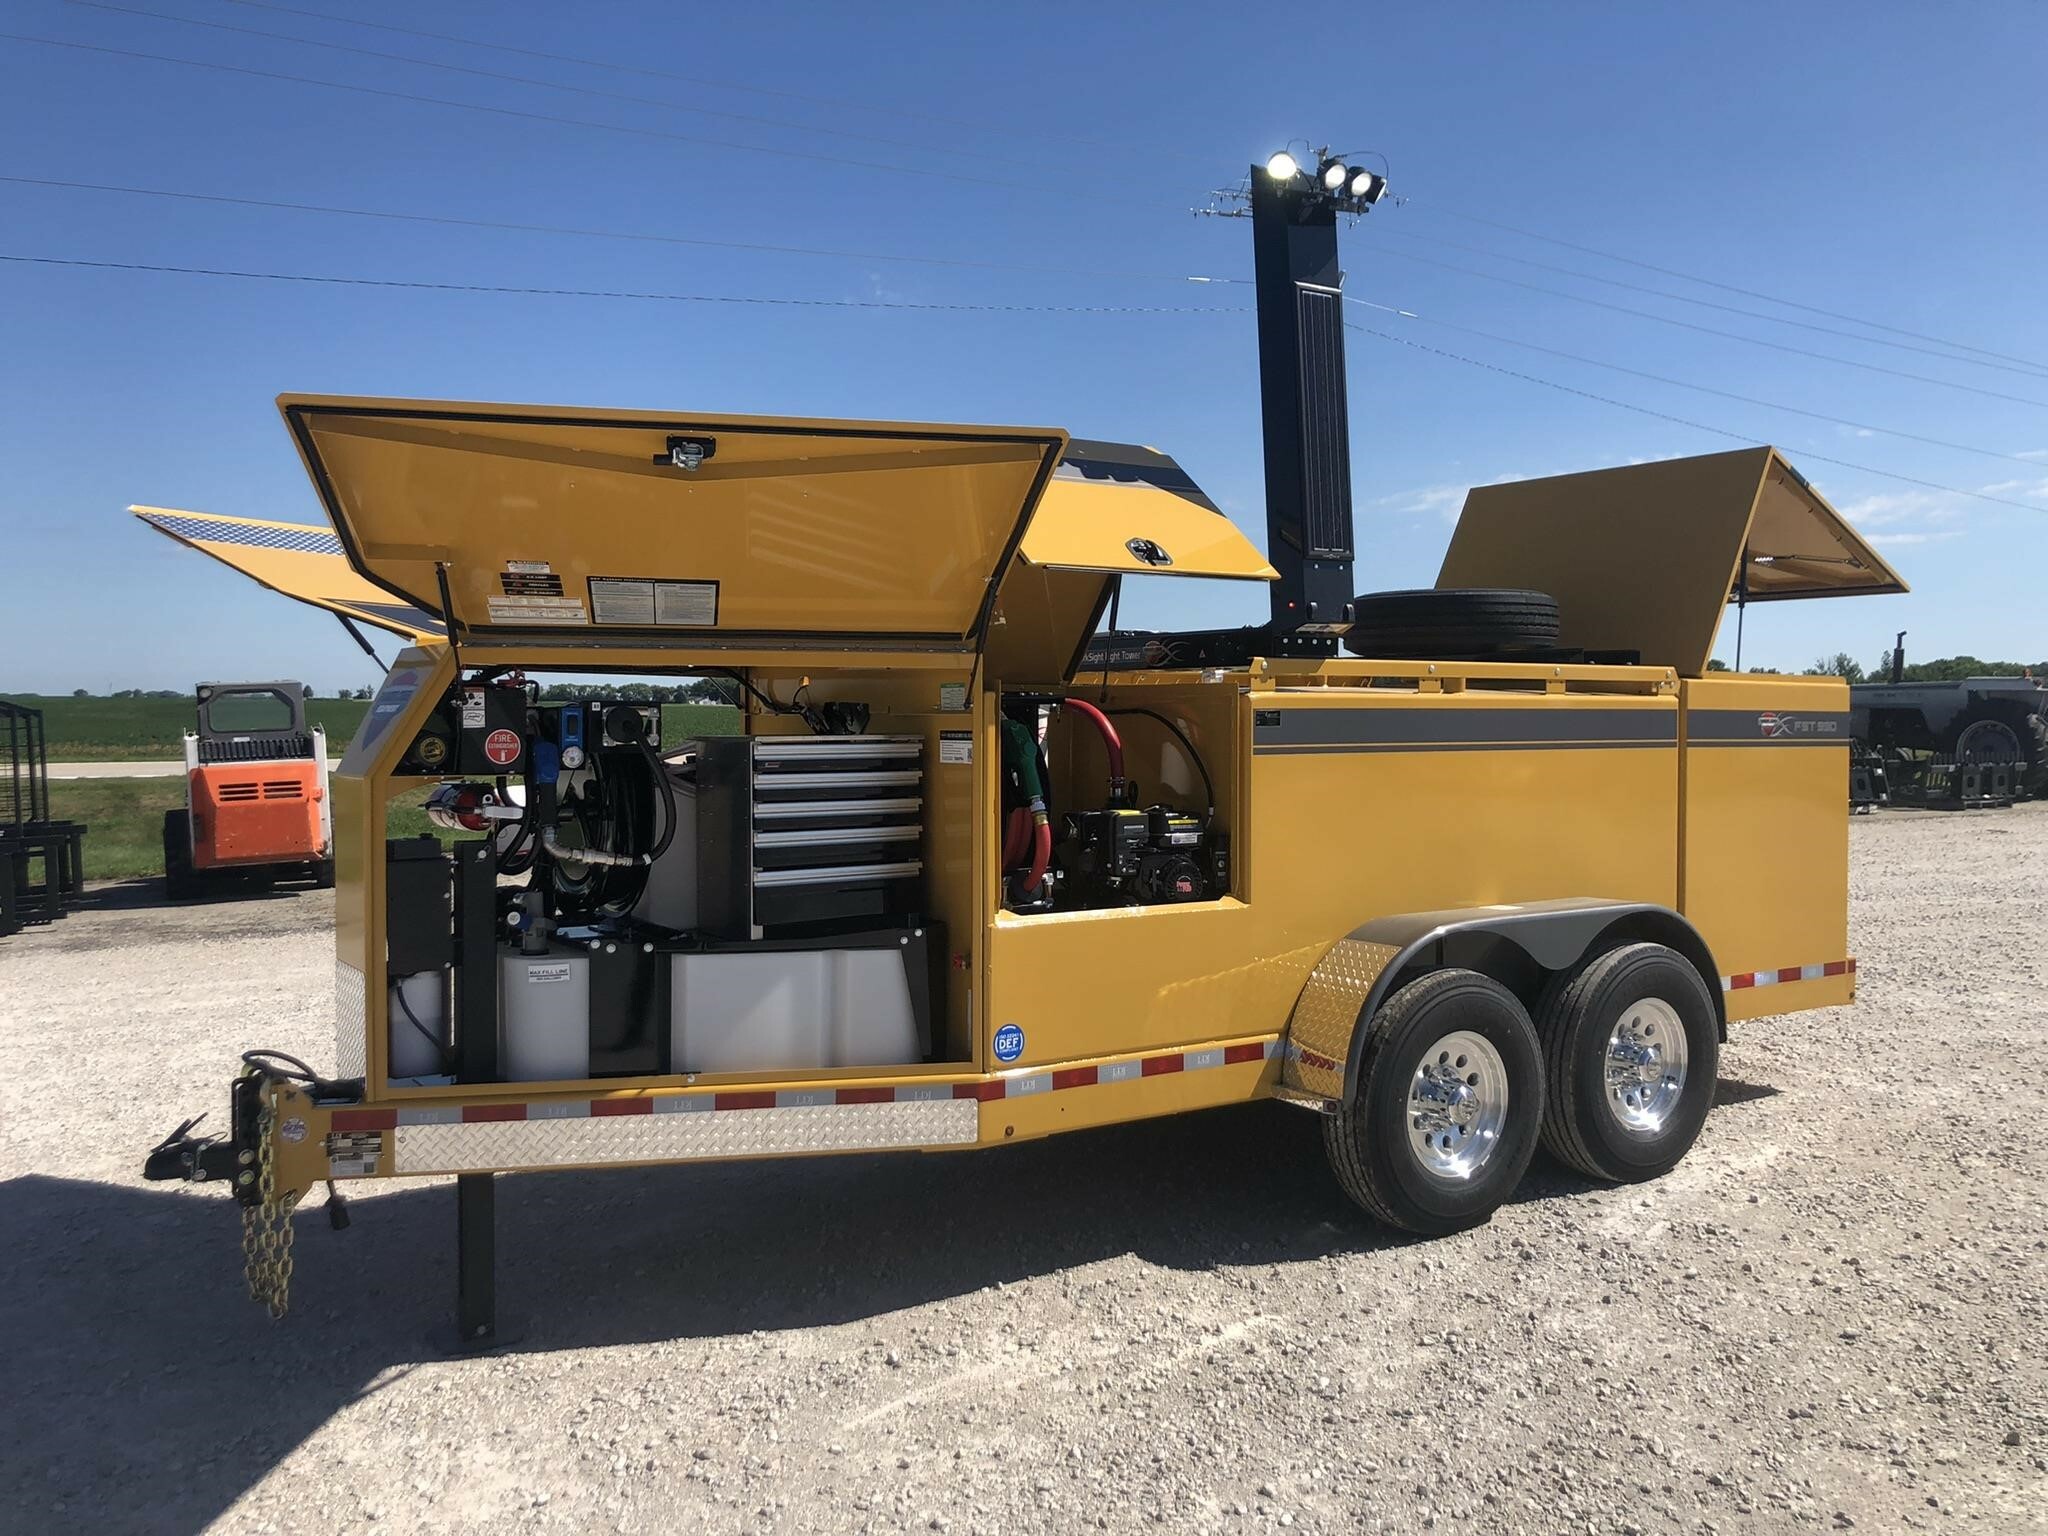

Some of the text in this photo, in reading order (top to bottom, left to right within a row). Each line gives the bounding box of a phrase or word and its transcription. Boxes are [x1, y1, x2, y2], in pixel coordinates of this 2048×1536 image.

[1121, 650, 1141, 660] Tower
[1794, 721, 1816, 732] FST
[494, 734, 512, 743] FIRE
[999, 1037, 1019, 1050] DEF
